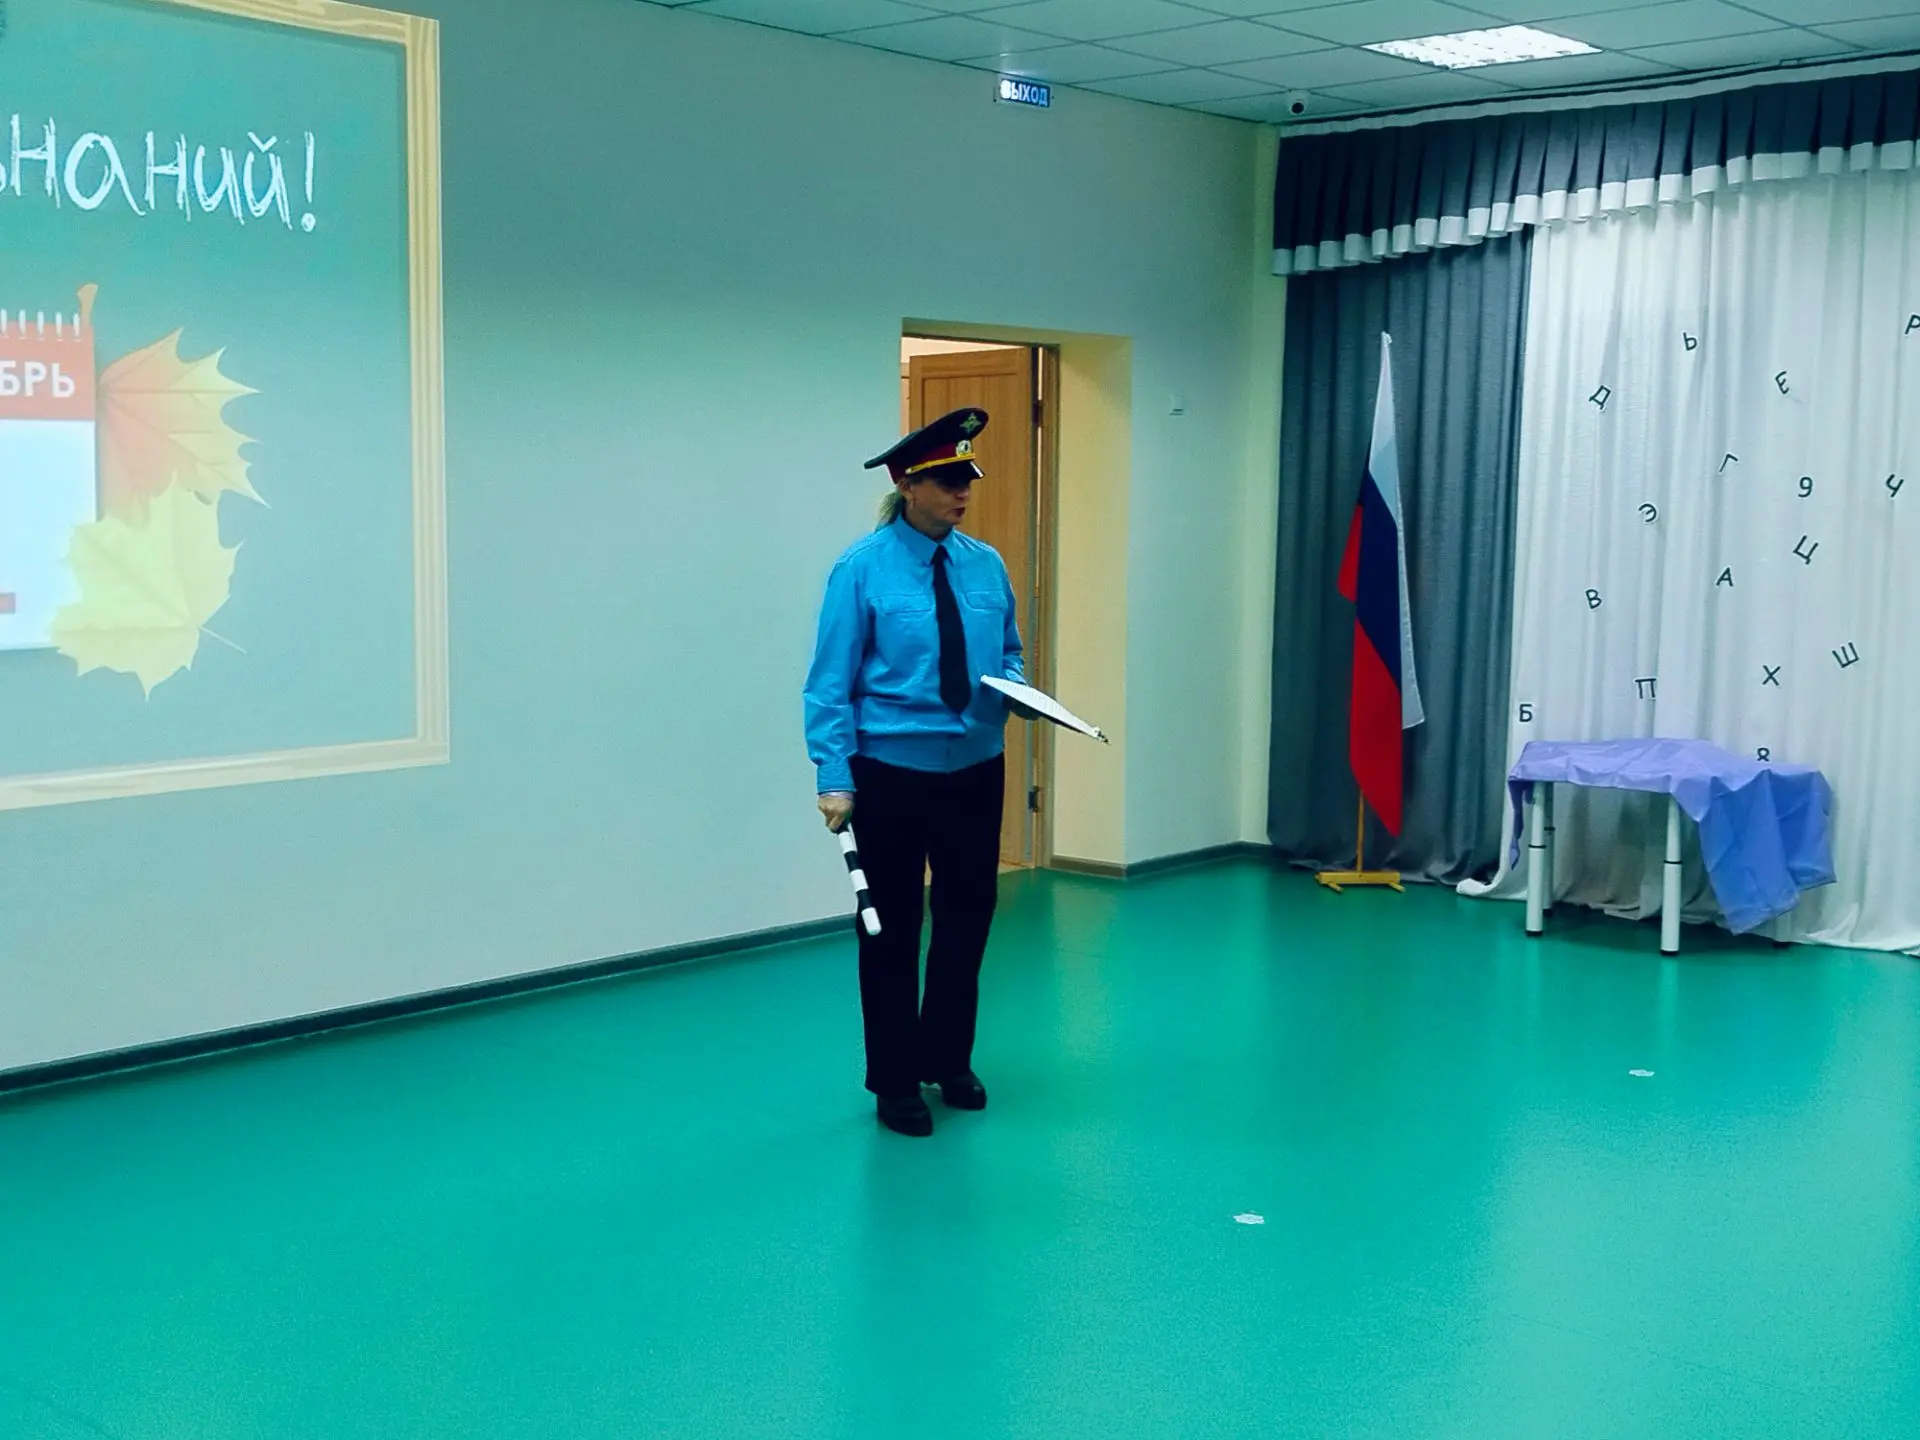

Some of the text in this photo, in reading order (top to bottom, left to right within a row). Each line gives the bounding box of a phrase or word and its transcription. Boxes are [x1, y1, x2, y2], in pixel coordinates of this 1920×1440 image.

[0, 114, 316, 232] наний!
[1588, 385, 1612, 410] Д
[1638, 503, 1657, 523] Э
[1792, 535, 1819, 565] Ц
[1716, 567, 1734, 587] А
[1585, 588, 1602, 610] В
[1831, 642, 1859, 669] Ш
[1635, 677, 1657, 702] П
[1519, 703, 1533, 723] Б
